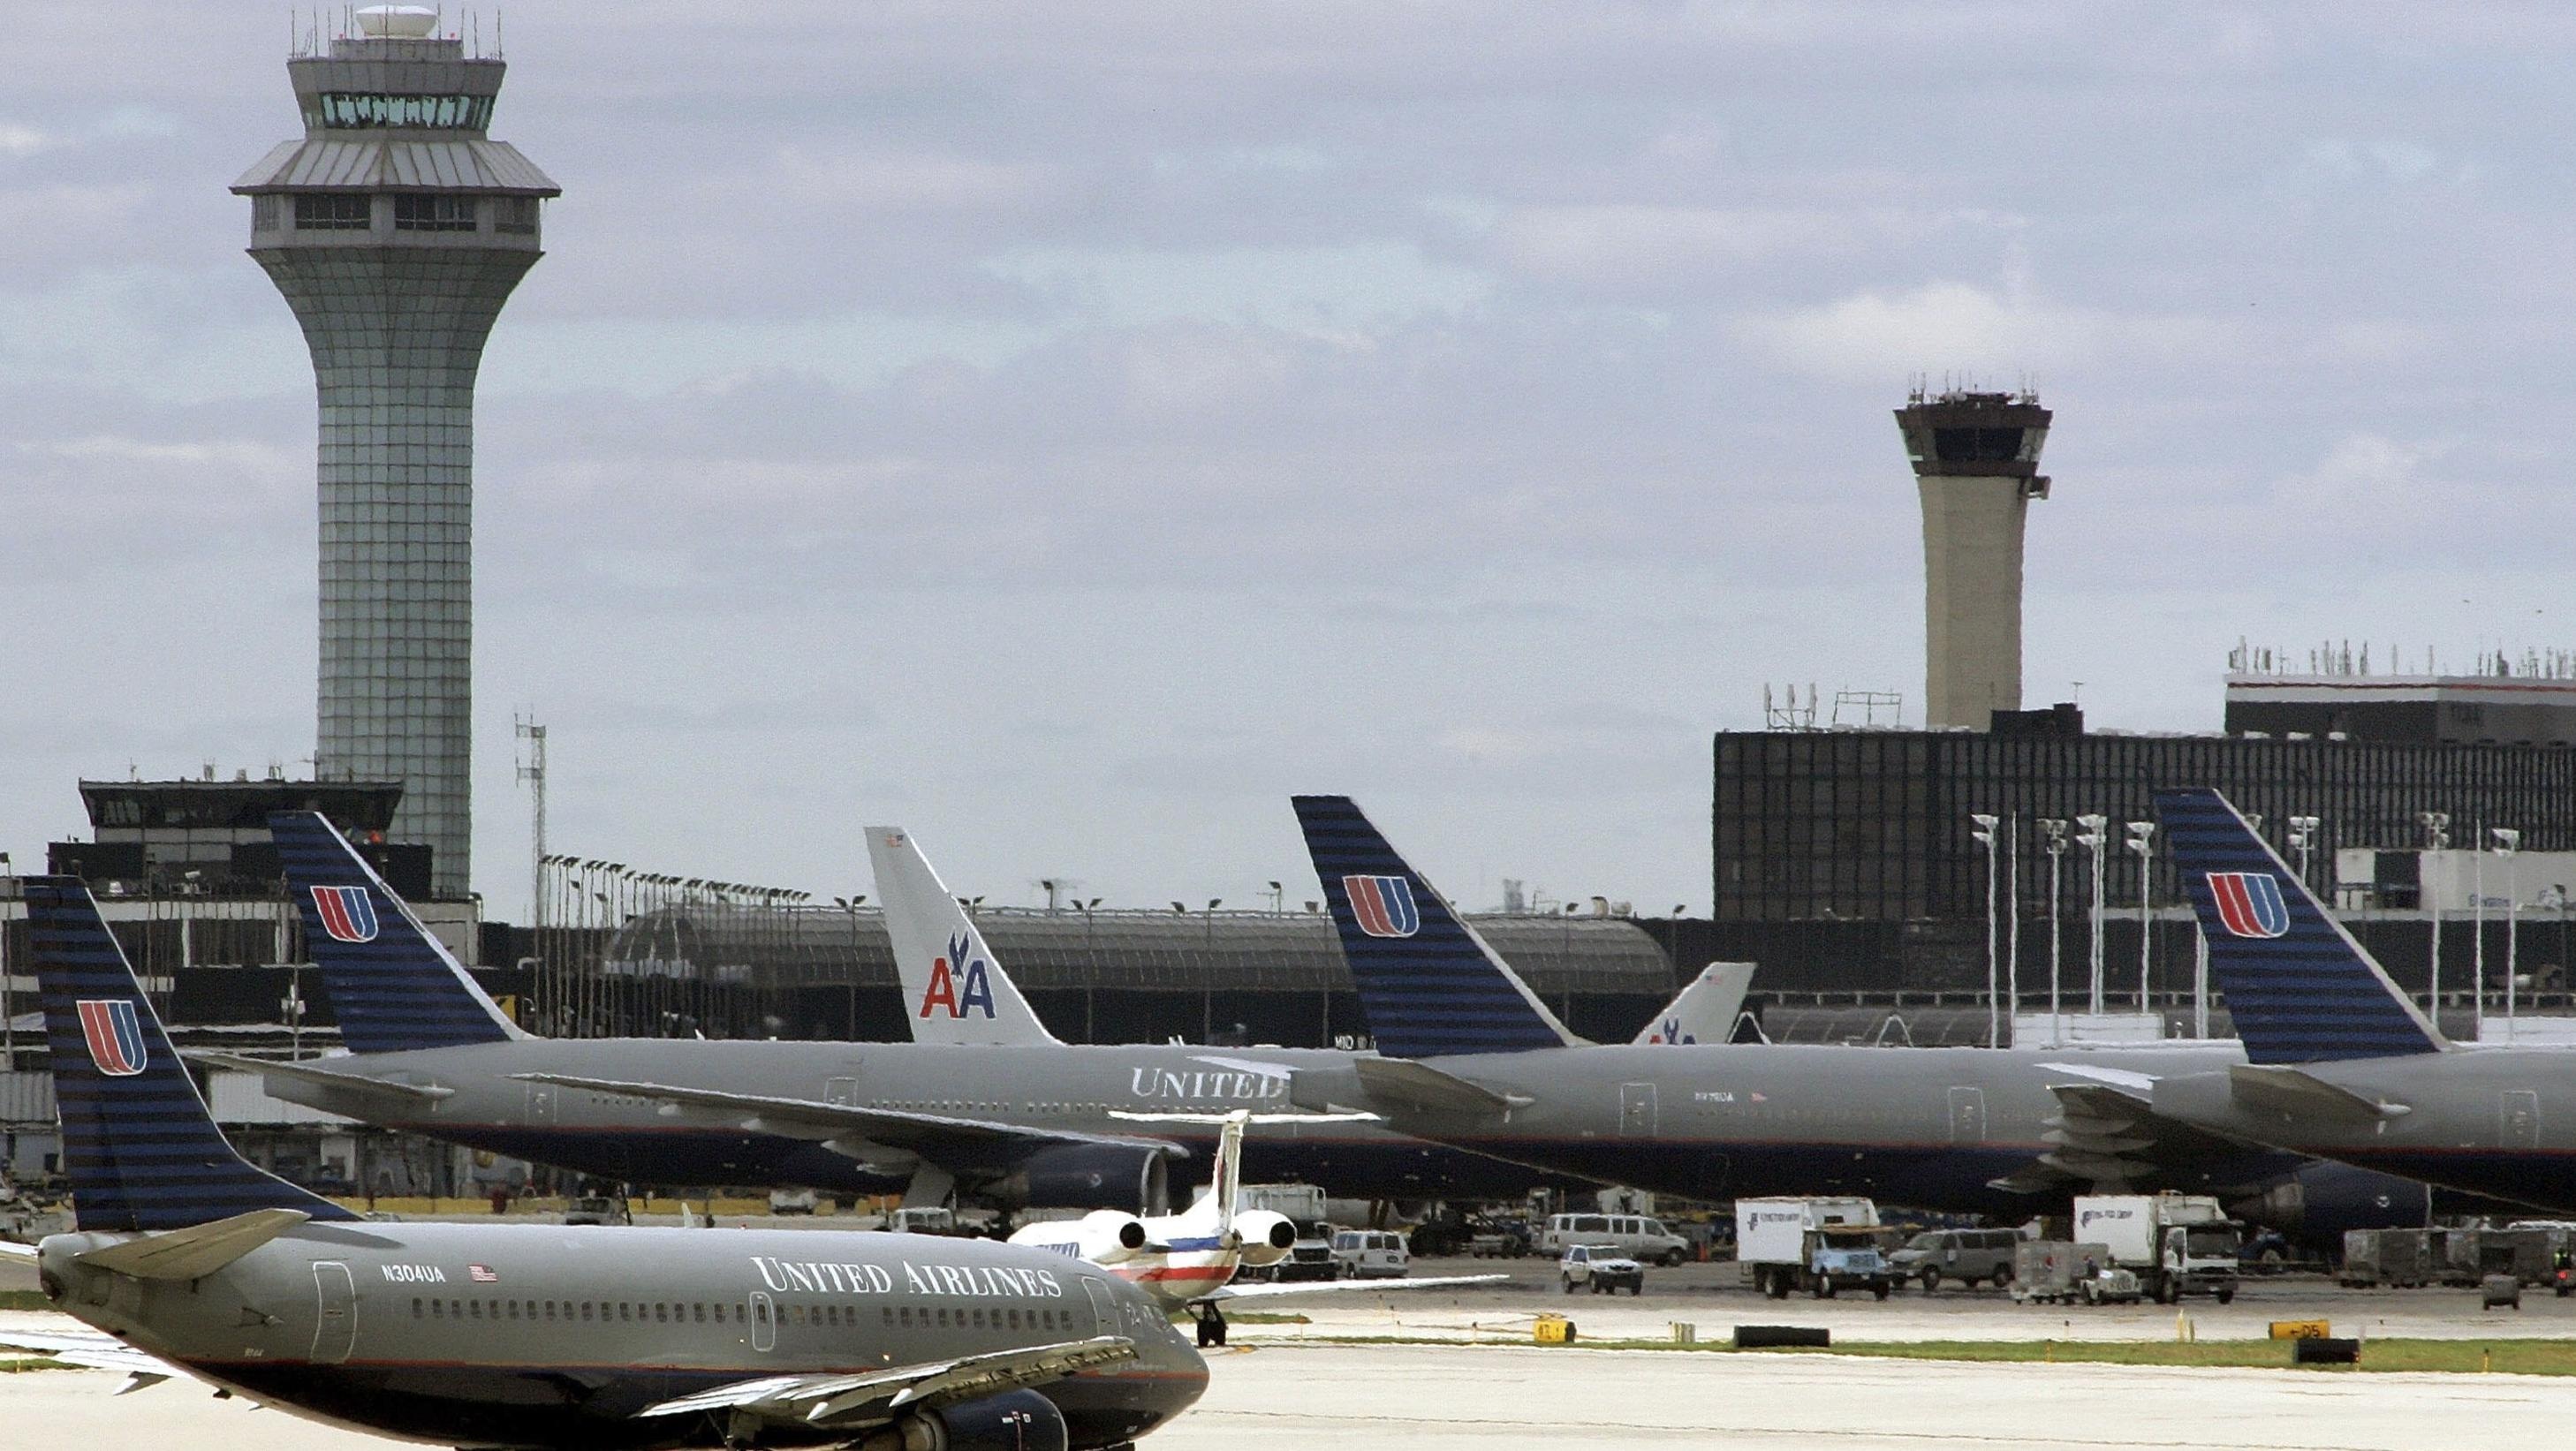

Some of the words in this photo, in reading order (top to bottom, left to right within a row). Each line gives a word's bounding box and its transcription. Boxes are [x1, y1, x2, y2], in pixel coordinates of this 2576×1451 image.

[919, 956, 996, 1020] AA
[1132, 1067, 1285, 1099] UNITED
[381, 1265, 446, 1283] N304UA
[750, 1258, 892, 1294] UNITED
[903, 1260, 1062, 1298] AIRLINES
